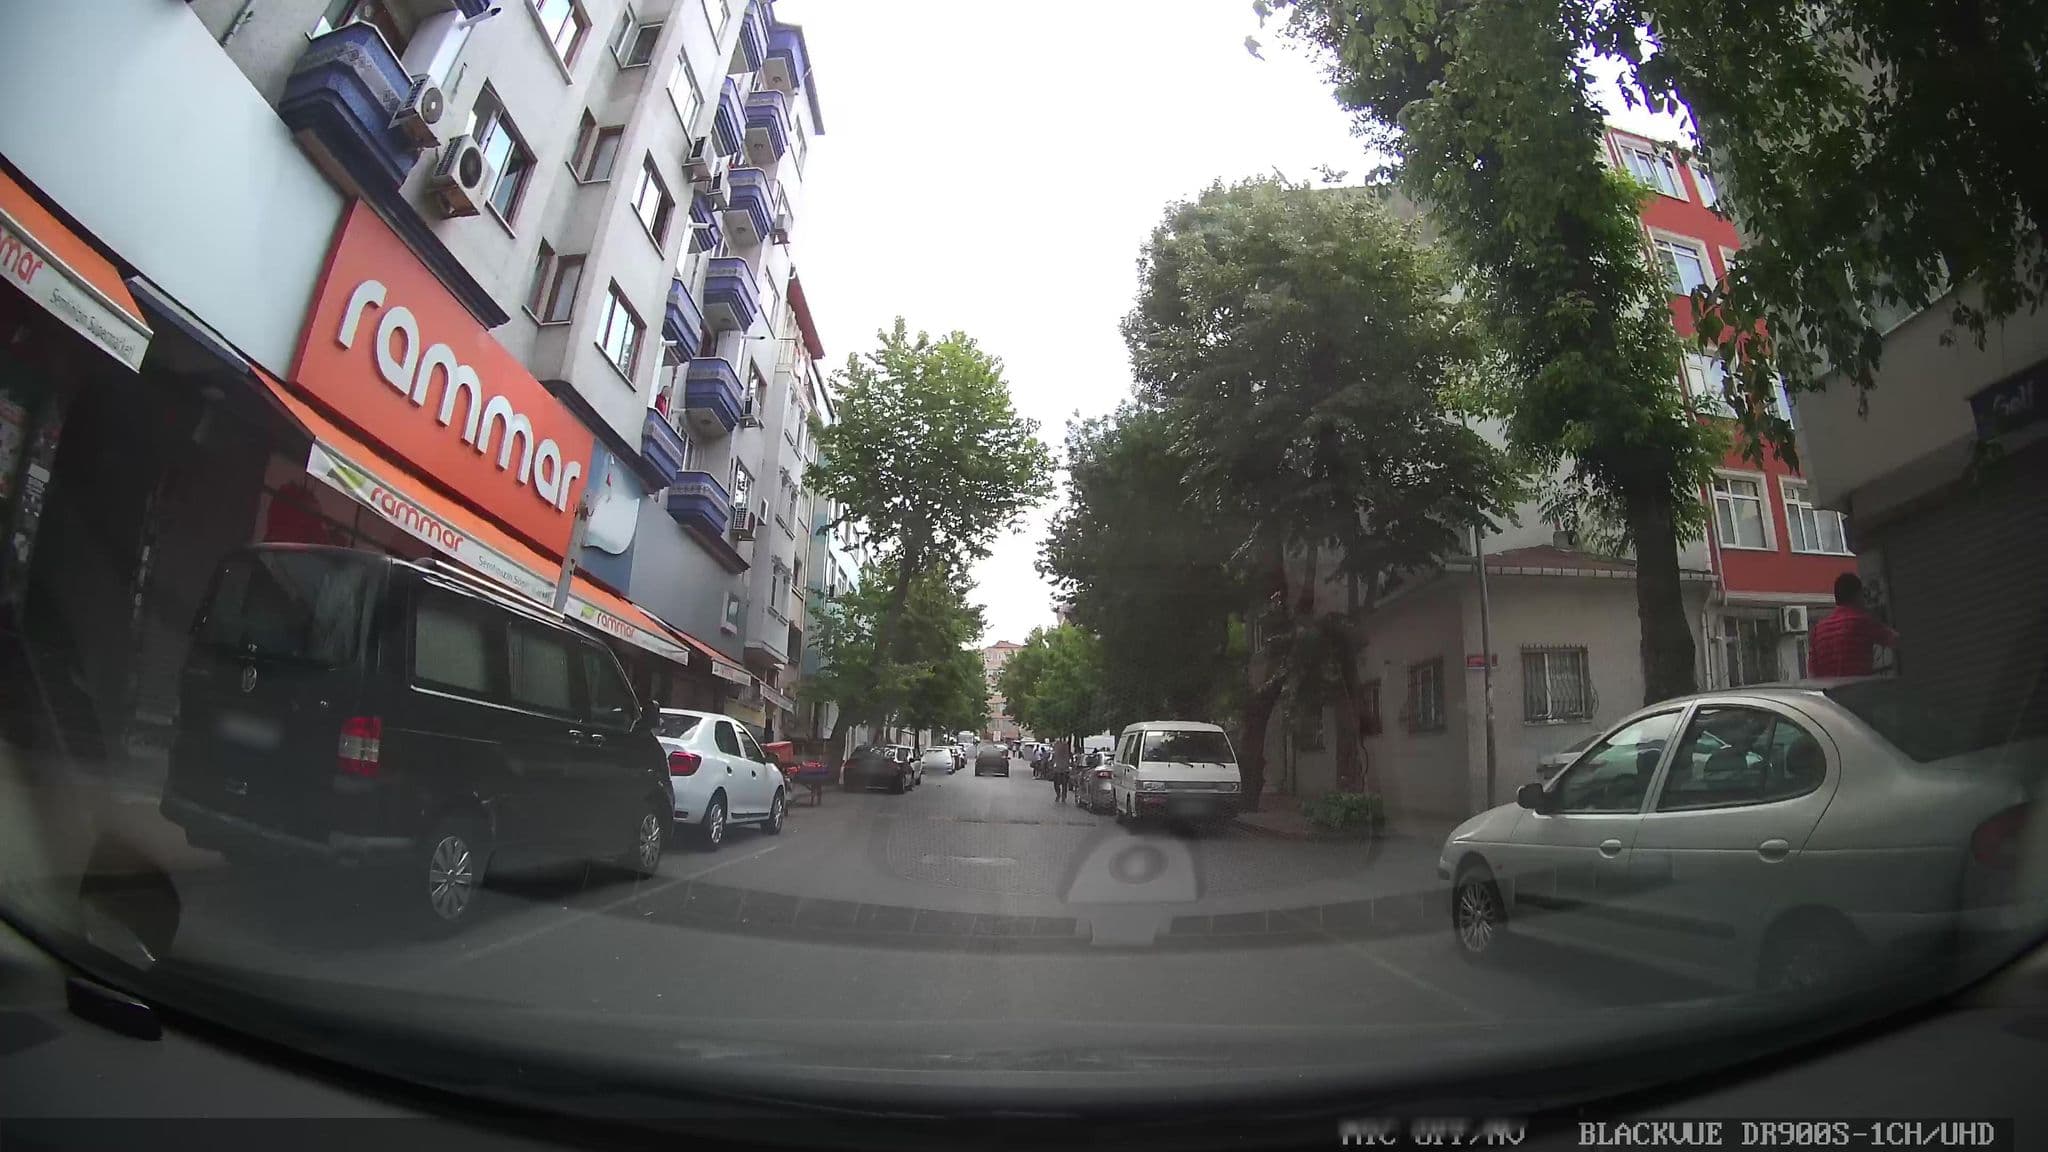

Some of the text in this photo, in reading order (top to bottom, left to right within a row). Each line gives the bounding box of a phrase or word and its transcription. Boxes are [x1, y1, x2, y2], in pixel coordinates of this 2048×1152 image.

[0, 226, 43, 284] mar
[336, 279, 582, 514] rammar
[370, 486, 464, 552] rammar
[597, 612, 635, 638] rammar
